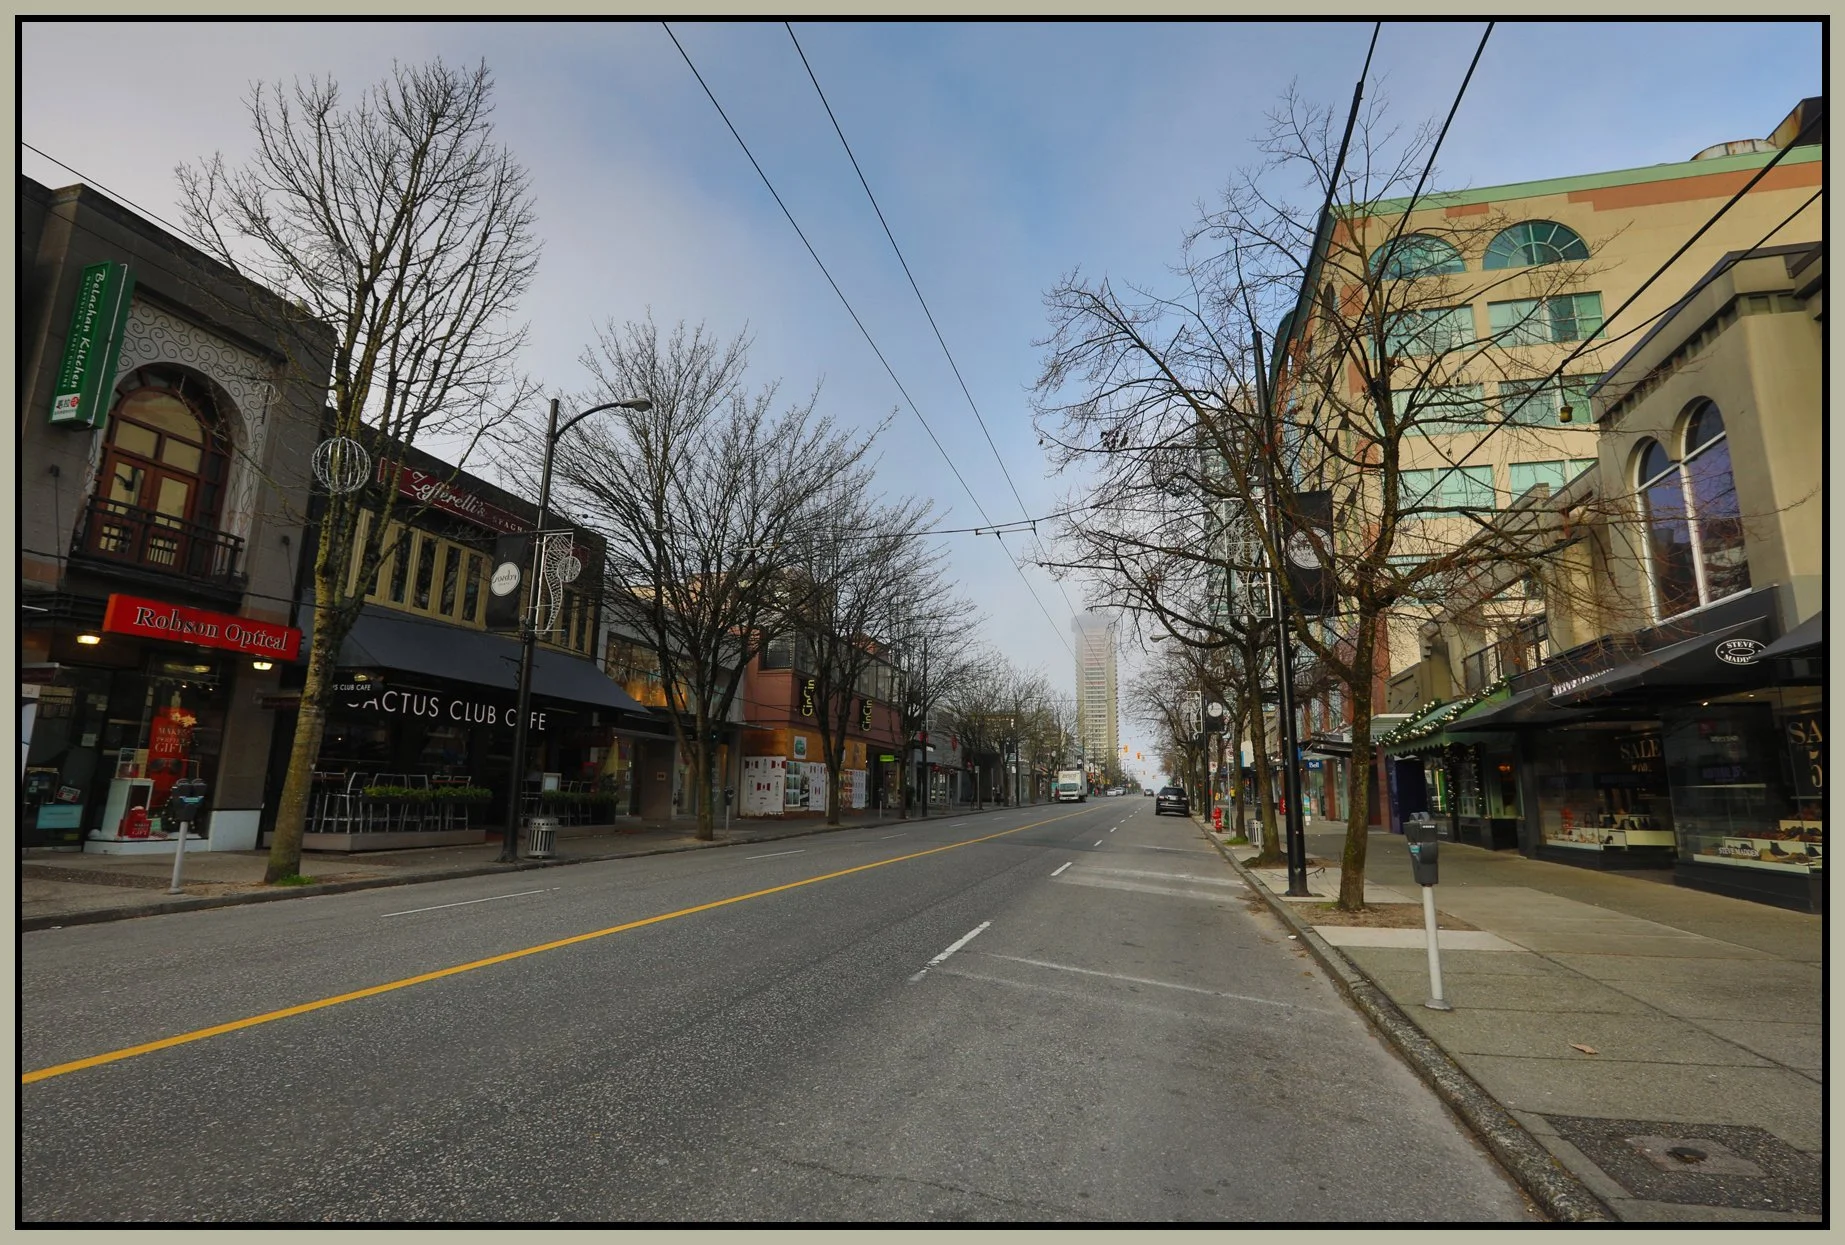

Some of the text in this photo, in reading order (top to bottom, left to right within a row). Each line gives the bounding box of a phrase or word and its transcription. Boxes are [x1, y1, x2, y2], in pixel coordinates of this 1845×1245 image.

[71, 268, 105, 388] Belachan Kitchen
[133, 606, 288, 651] Robson Optical
[1726, 641, 1755, 649] STEVE
[1724, 654, 1754, 663] MADD
[339, 683, 355, 691] CLUB
[355, 683, 372, 691] CAFE
[802, 679, 814, 716] CinCin
[347, 690, 547, 731] ACTUS CLUB CFE
[862, 699, 873, 731] CinCin
[154, 743, 184, 753] GIFT
[1620, 739, 1661, 760] SALE
